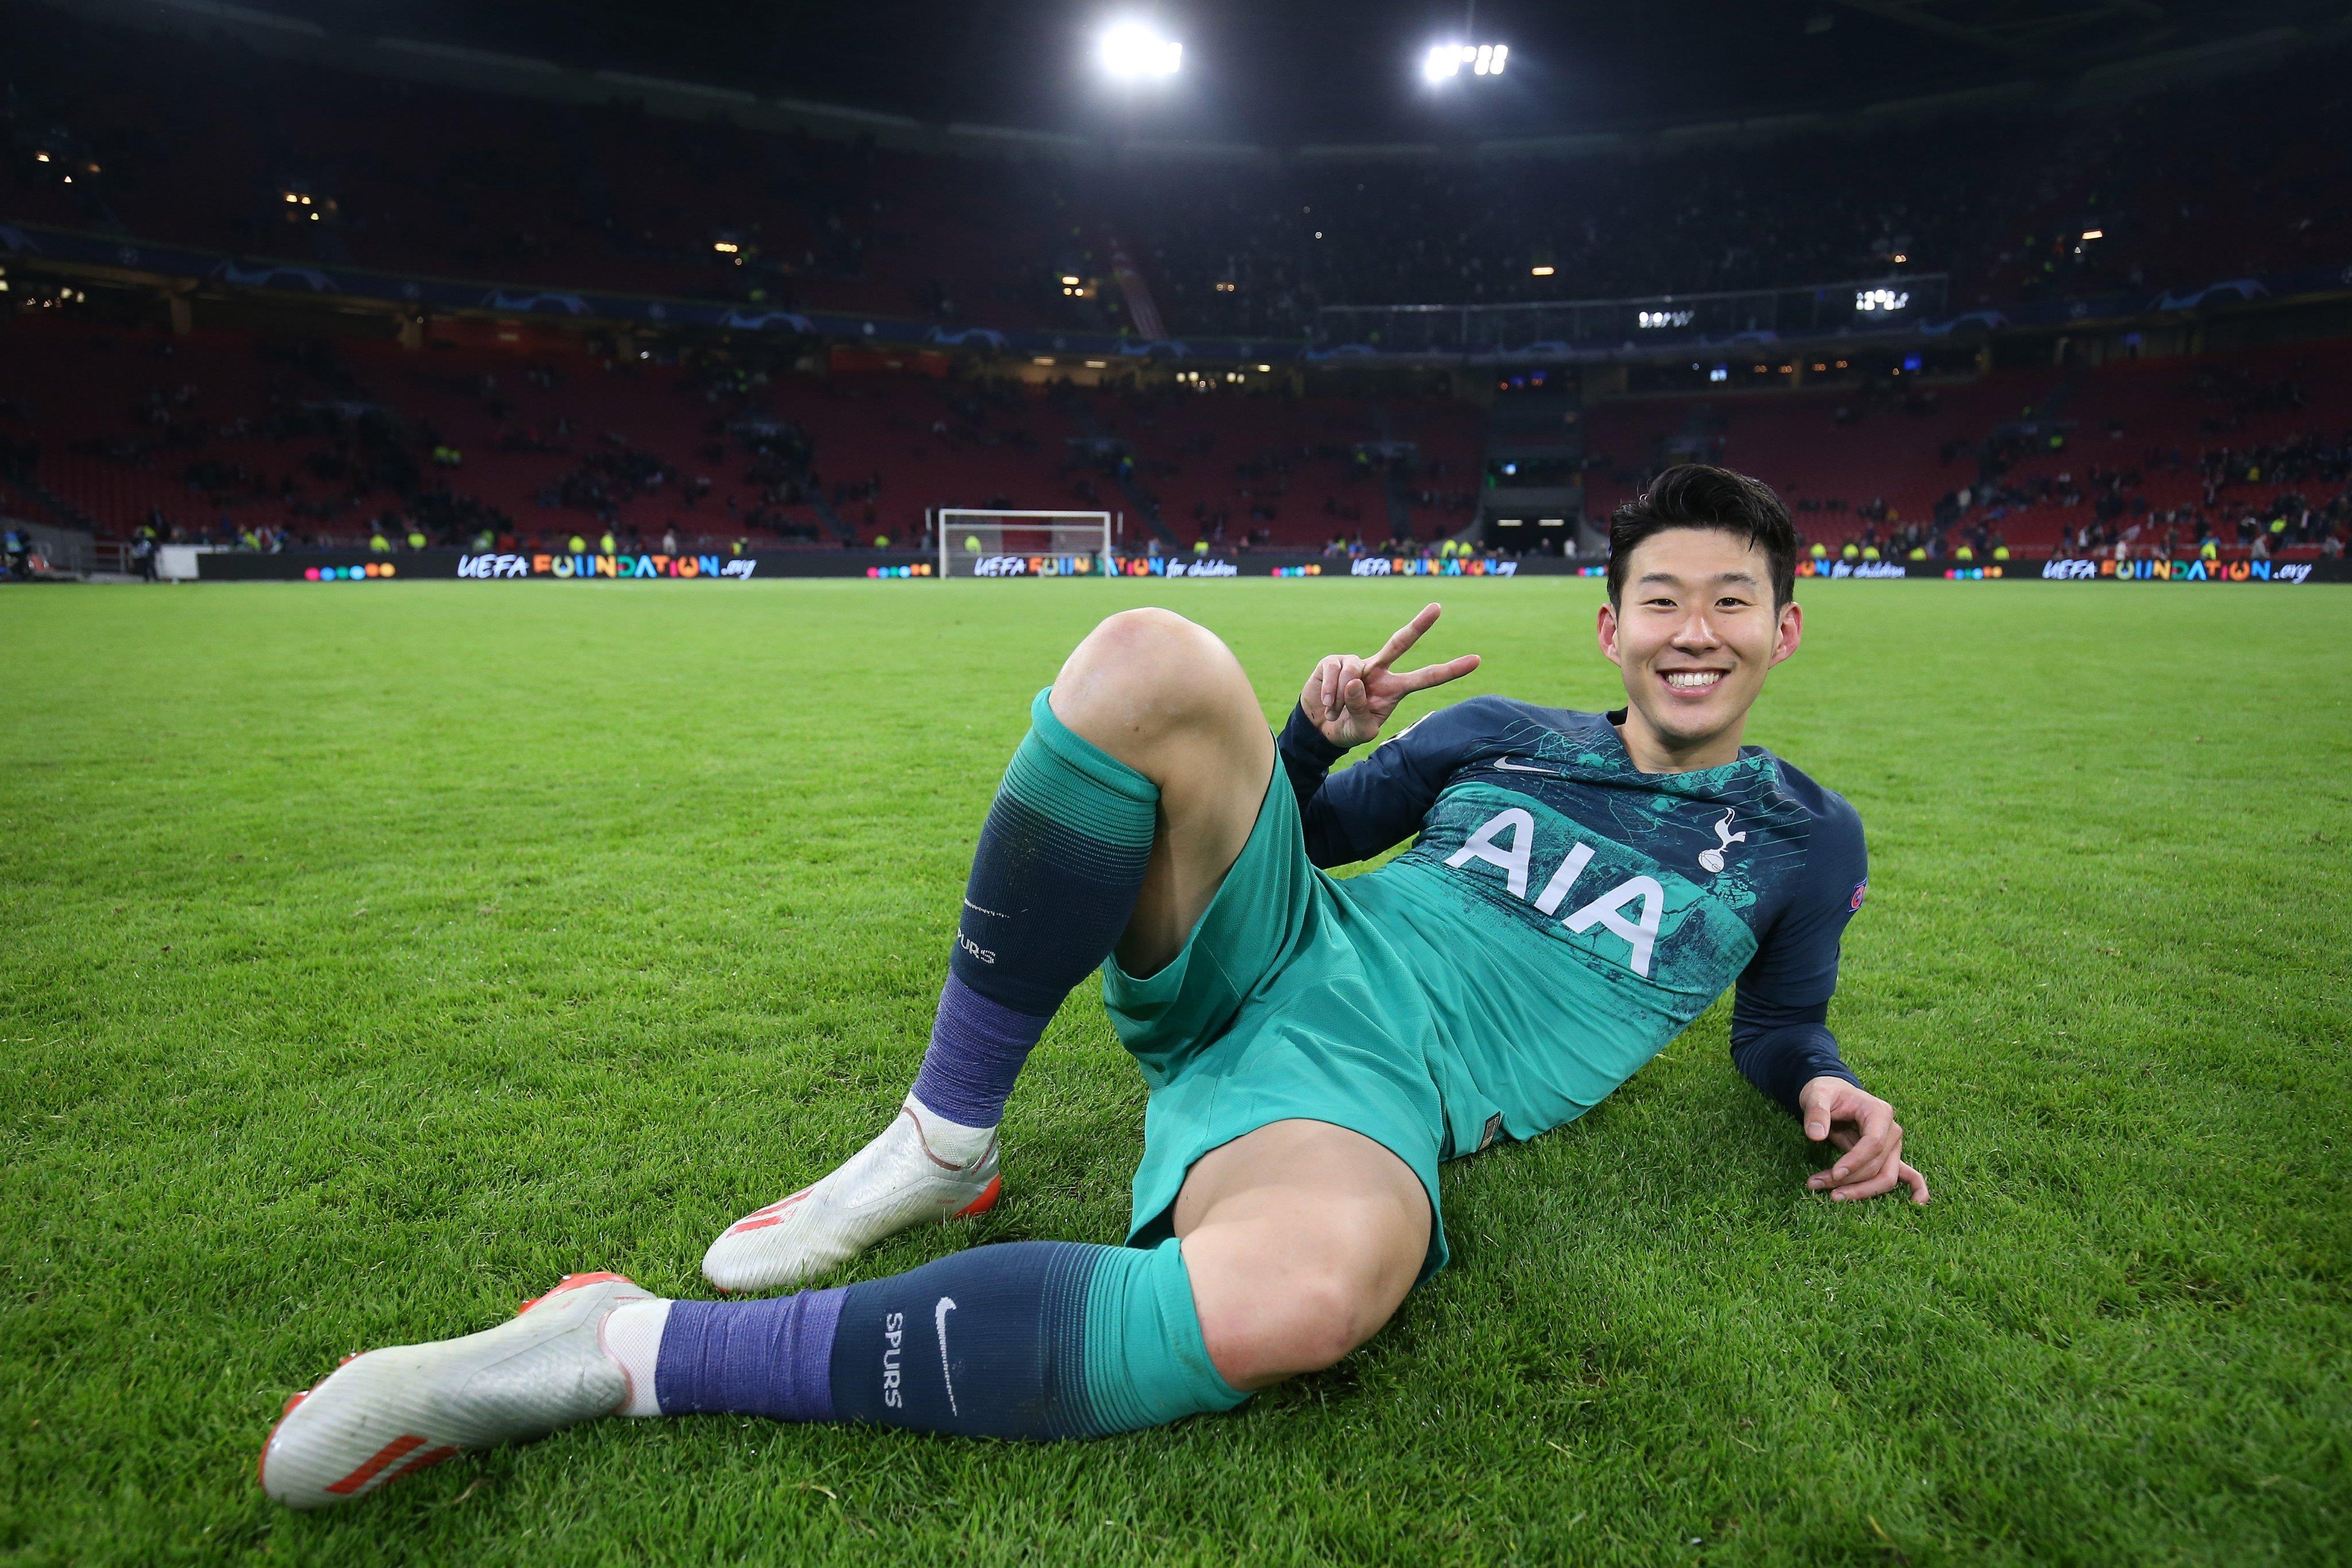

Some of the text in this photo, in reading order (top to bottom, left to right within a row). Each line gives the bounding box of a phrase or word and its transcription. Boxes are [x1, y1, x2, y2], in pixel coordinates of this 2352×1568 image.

[457, 553, 529, 578] UEFA
[974, 556, 1026, 577] UEFA
[1166, 557, 1187, 579] for
[1351, 557, 1391, 576] UEFA
[2042, 559, 2097, 579] UEFA
[1444, 808, 1664, 978] AIA
[884, 1312, 903, 1408] SPURS
